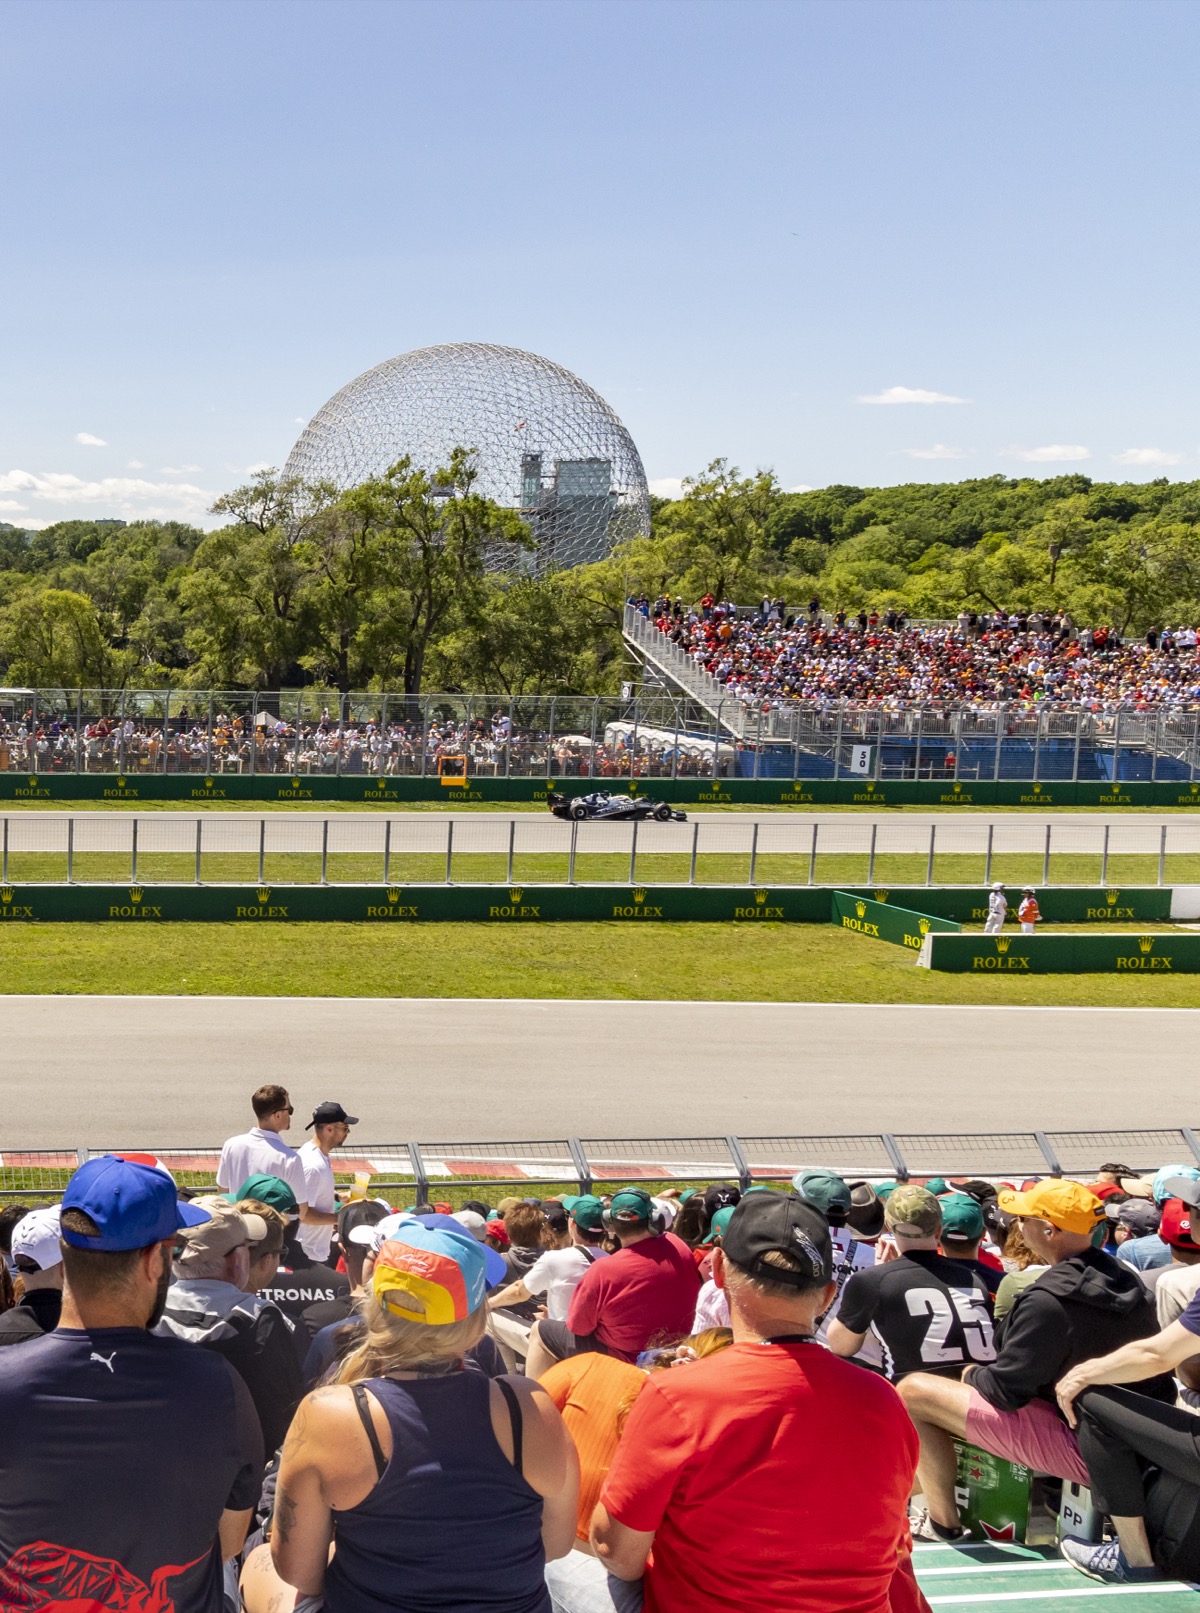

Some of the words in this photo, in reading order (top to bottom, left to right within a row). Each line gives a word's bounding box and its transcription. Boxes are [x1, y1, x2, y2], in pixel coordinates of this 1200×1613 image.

[859, 751, 866, 768] 50
[15, 789, 50, 797] ROLEX
[103, 789, 139, 797] ROLEX
[191, 789, 226, 797] ROLEX
[278, 790, 312, 798] ROLEX
[109, 906, 162, 917] ROLEX
[236, 906, 289, 917] ROLEX
[367, 906, 418, 917] ROLEX
[489, 906, 540, 917] ROLEX
[613, 906, 663, 917] ROLEX
[735, 907, 784, 918] ROLEX
[972, 908, 1019, 918] ROX
[1086, 907, 1135, 919] ROLEX
[842, 916, 879, 937] ROLEX
[973, 956, 1030, 969] ROLEX
[1116, 956, 1173, 969] ROLEX
[904, 1287, 998, 1363] 25
[1063, 1505, 1083, 1526] PP
